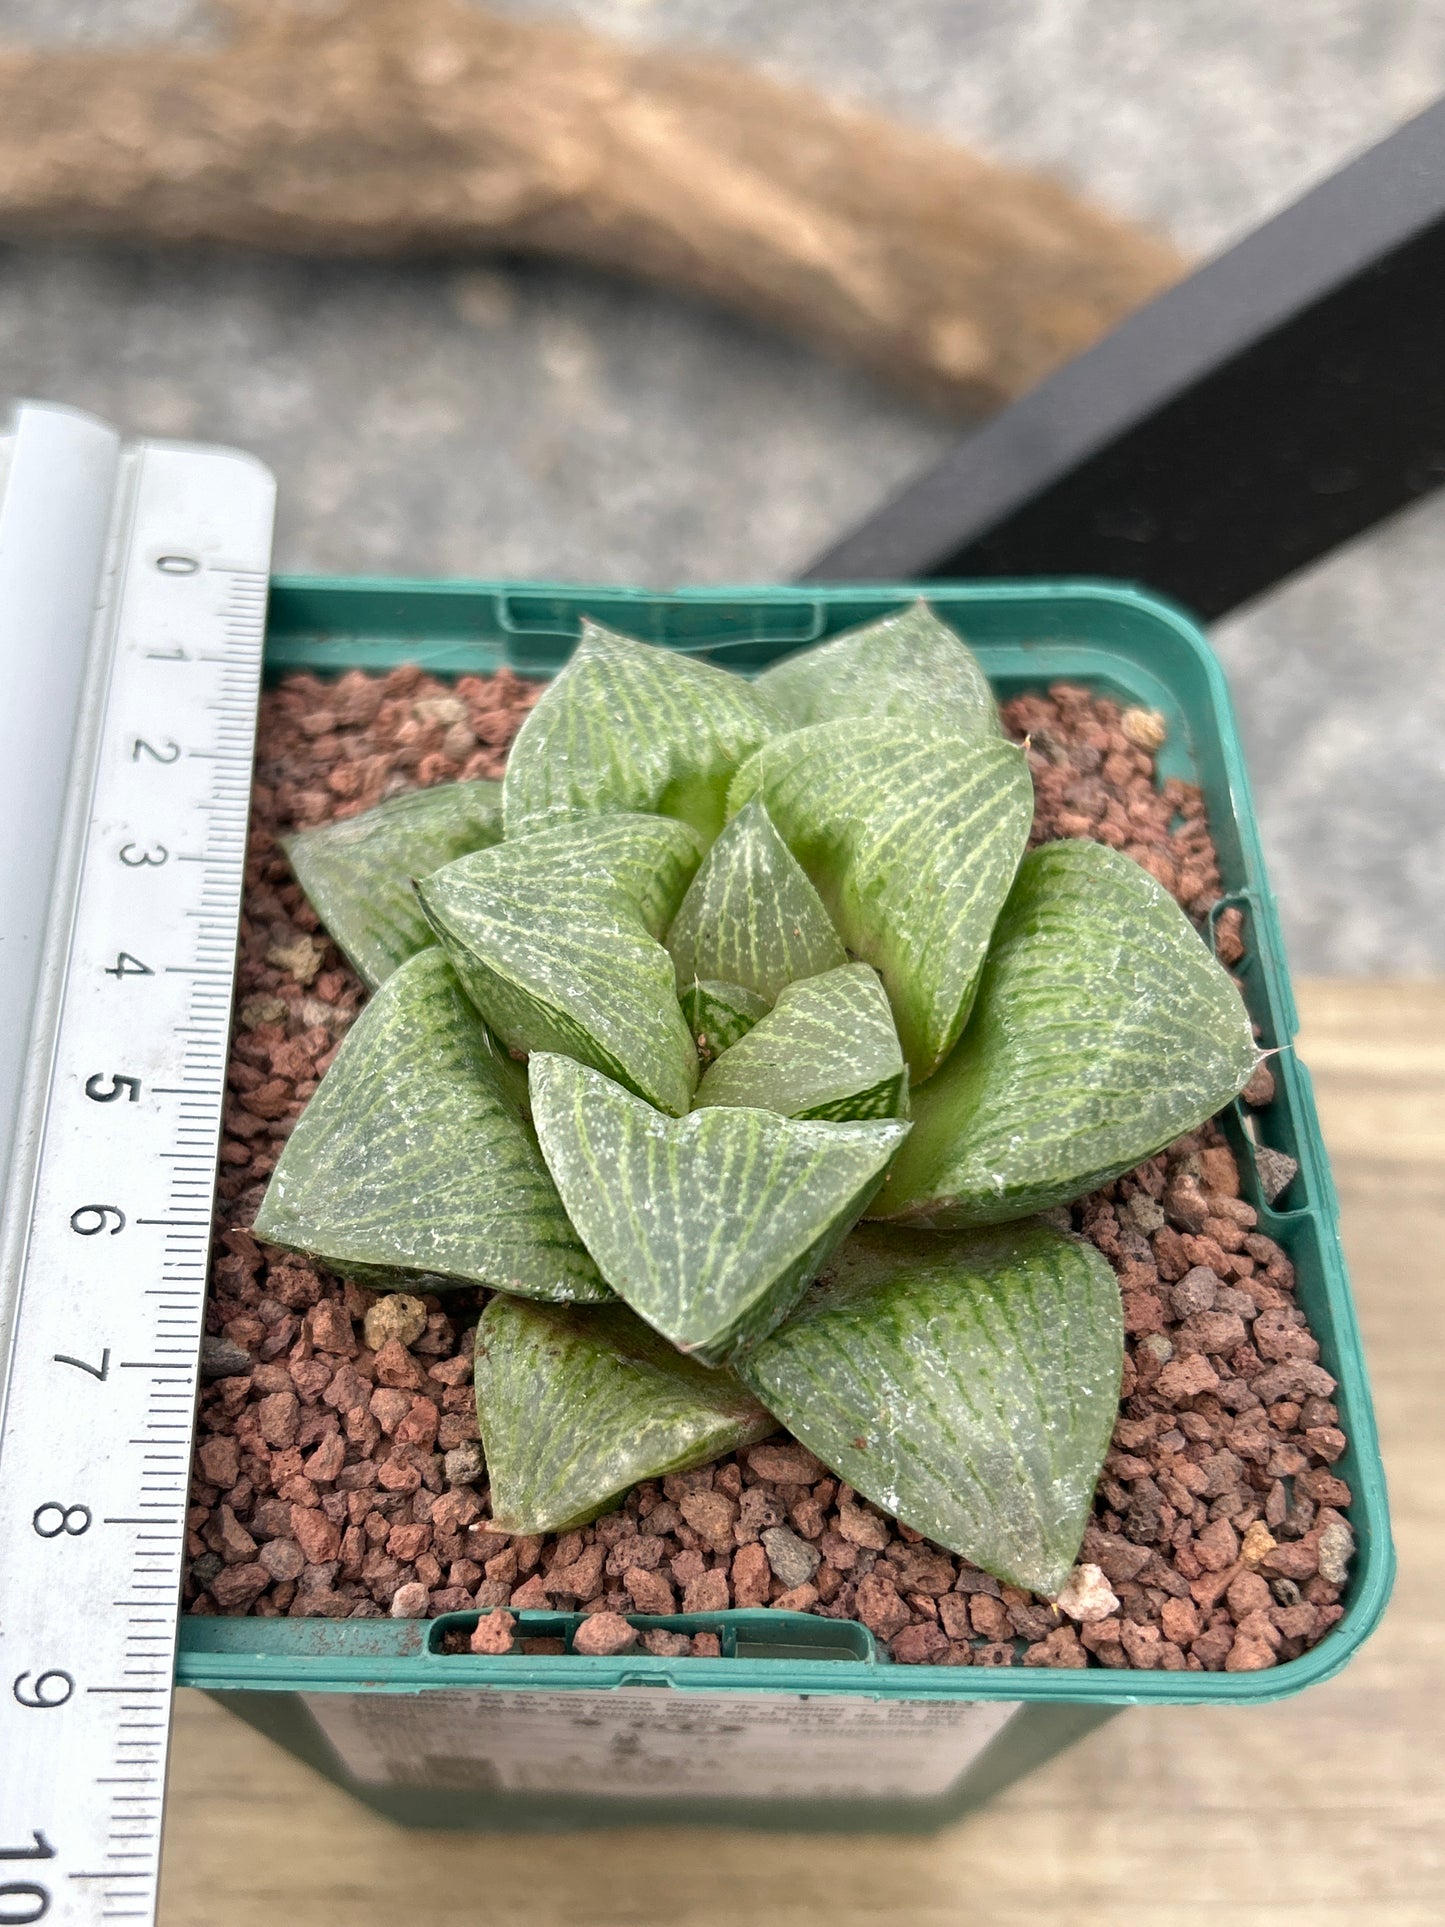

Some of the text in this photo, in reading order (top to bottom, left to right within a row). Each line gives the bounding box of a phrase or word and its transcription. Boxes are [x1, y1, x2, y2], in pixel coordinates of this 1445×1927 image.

[156, 555, 199, 576] 0
[146, 647, 191, 661] 1
[132, 738, 181, 763] 2
[119, 843, 169, 869] 3
[105, 952, 155, 980] 4
[85, 1072, 142, 1104] 5
[70, 1204, 126, 1235] 6
[54, 1348, 111, 1382] 7
[33, 1501, 92, 1537] 8
[13, 1669, 77, 1708] 9
[0, 1829, 58, 1925] 10
